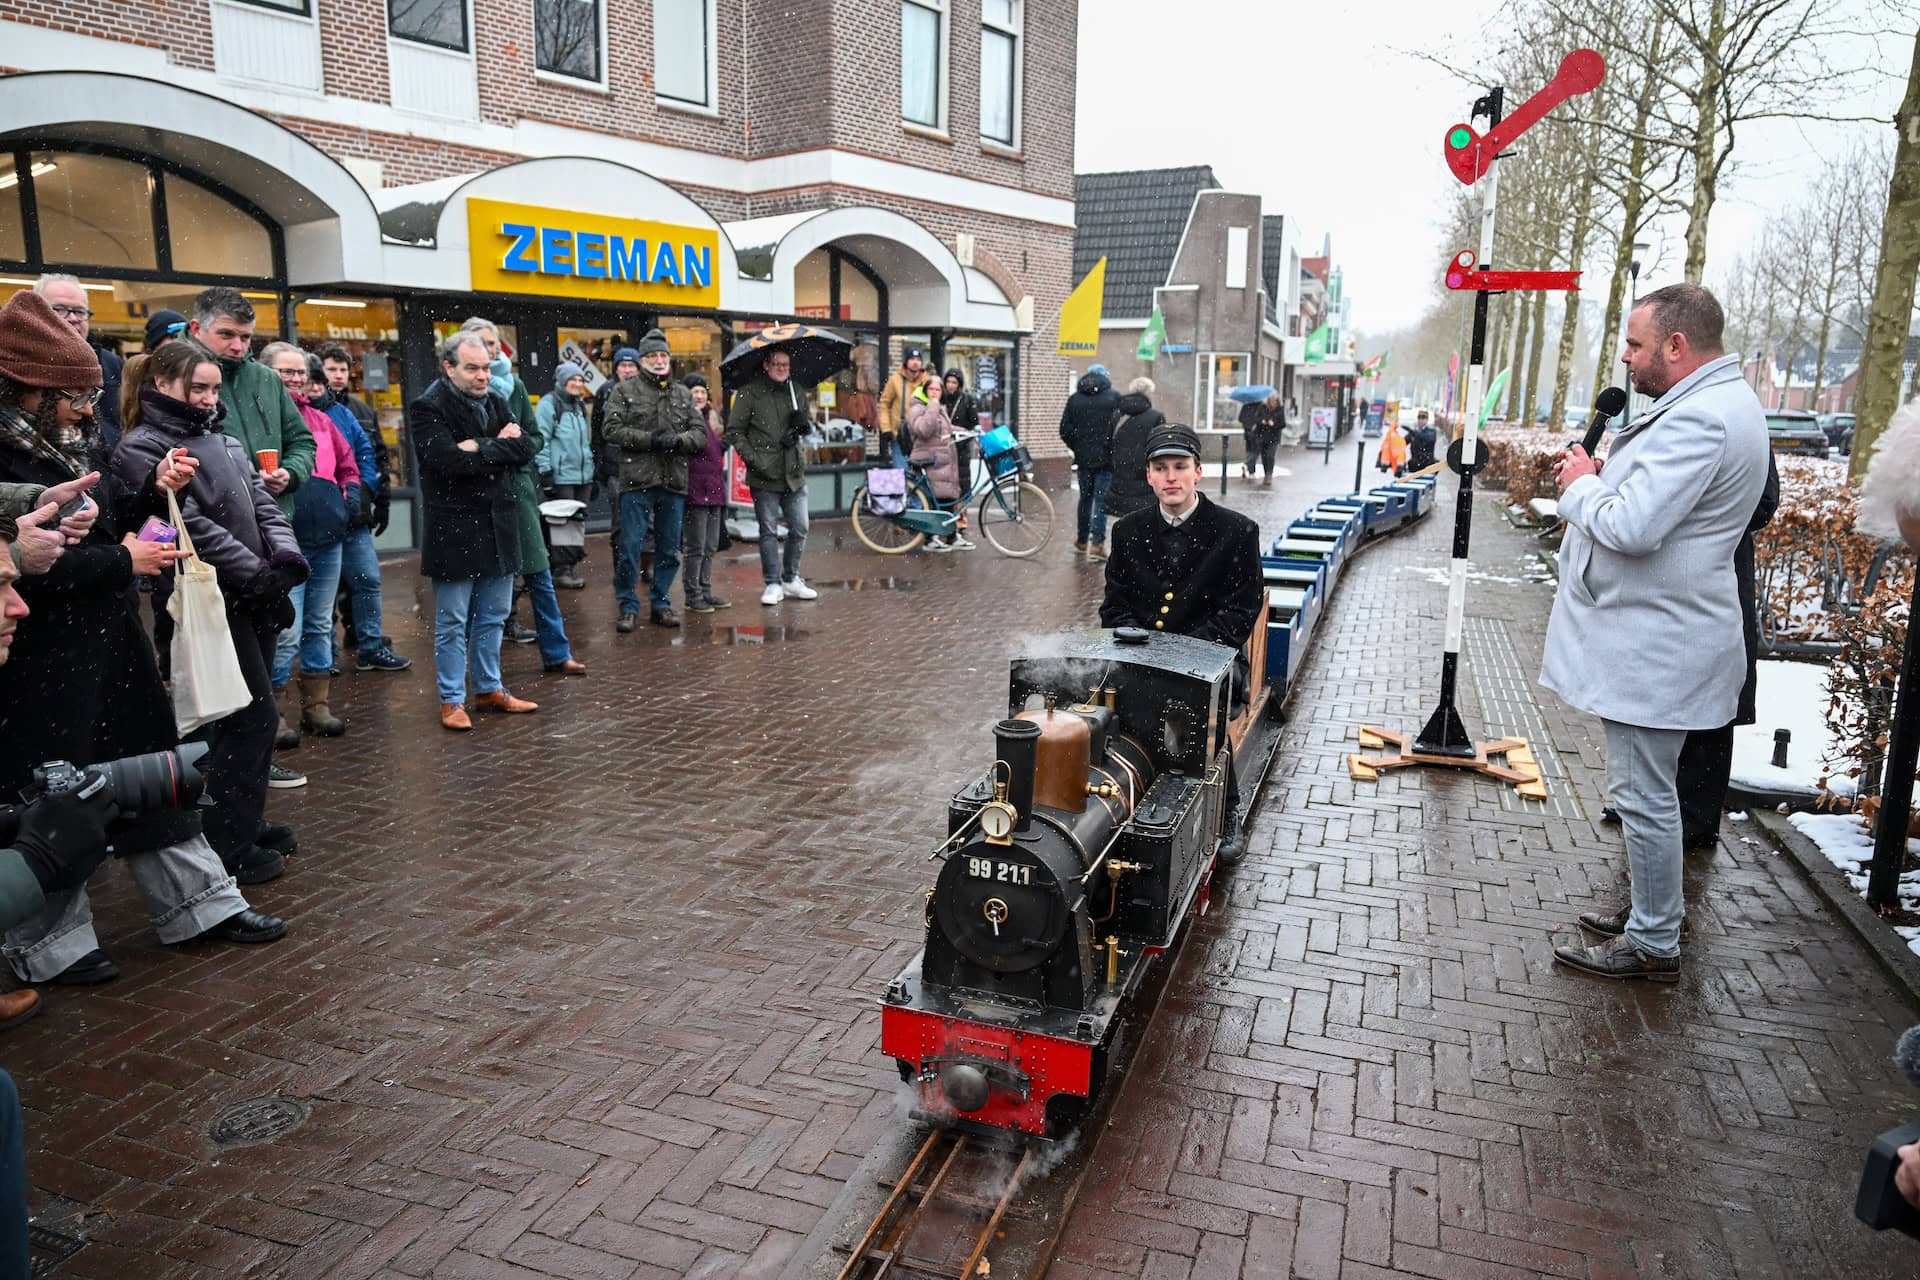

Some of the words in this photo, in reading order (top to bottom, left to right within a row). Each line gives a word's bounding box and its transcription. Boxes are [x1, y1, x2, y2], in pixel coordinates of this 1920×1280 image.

[501, 222, 711, 287] ZEEMAN
[1060, 342, 1095, 350] ZEEMAN
[562, 346, 594, 383] Sale
[969, 857, 992, 879] 99
